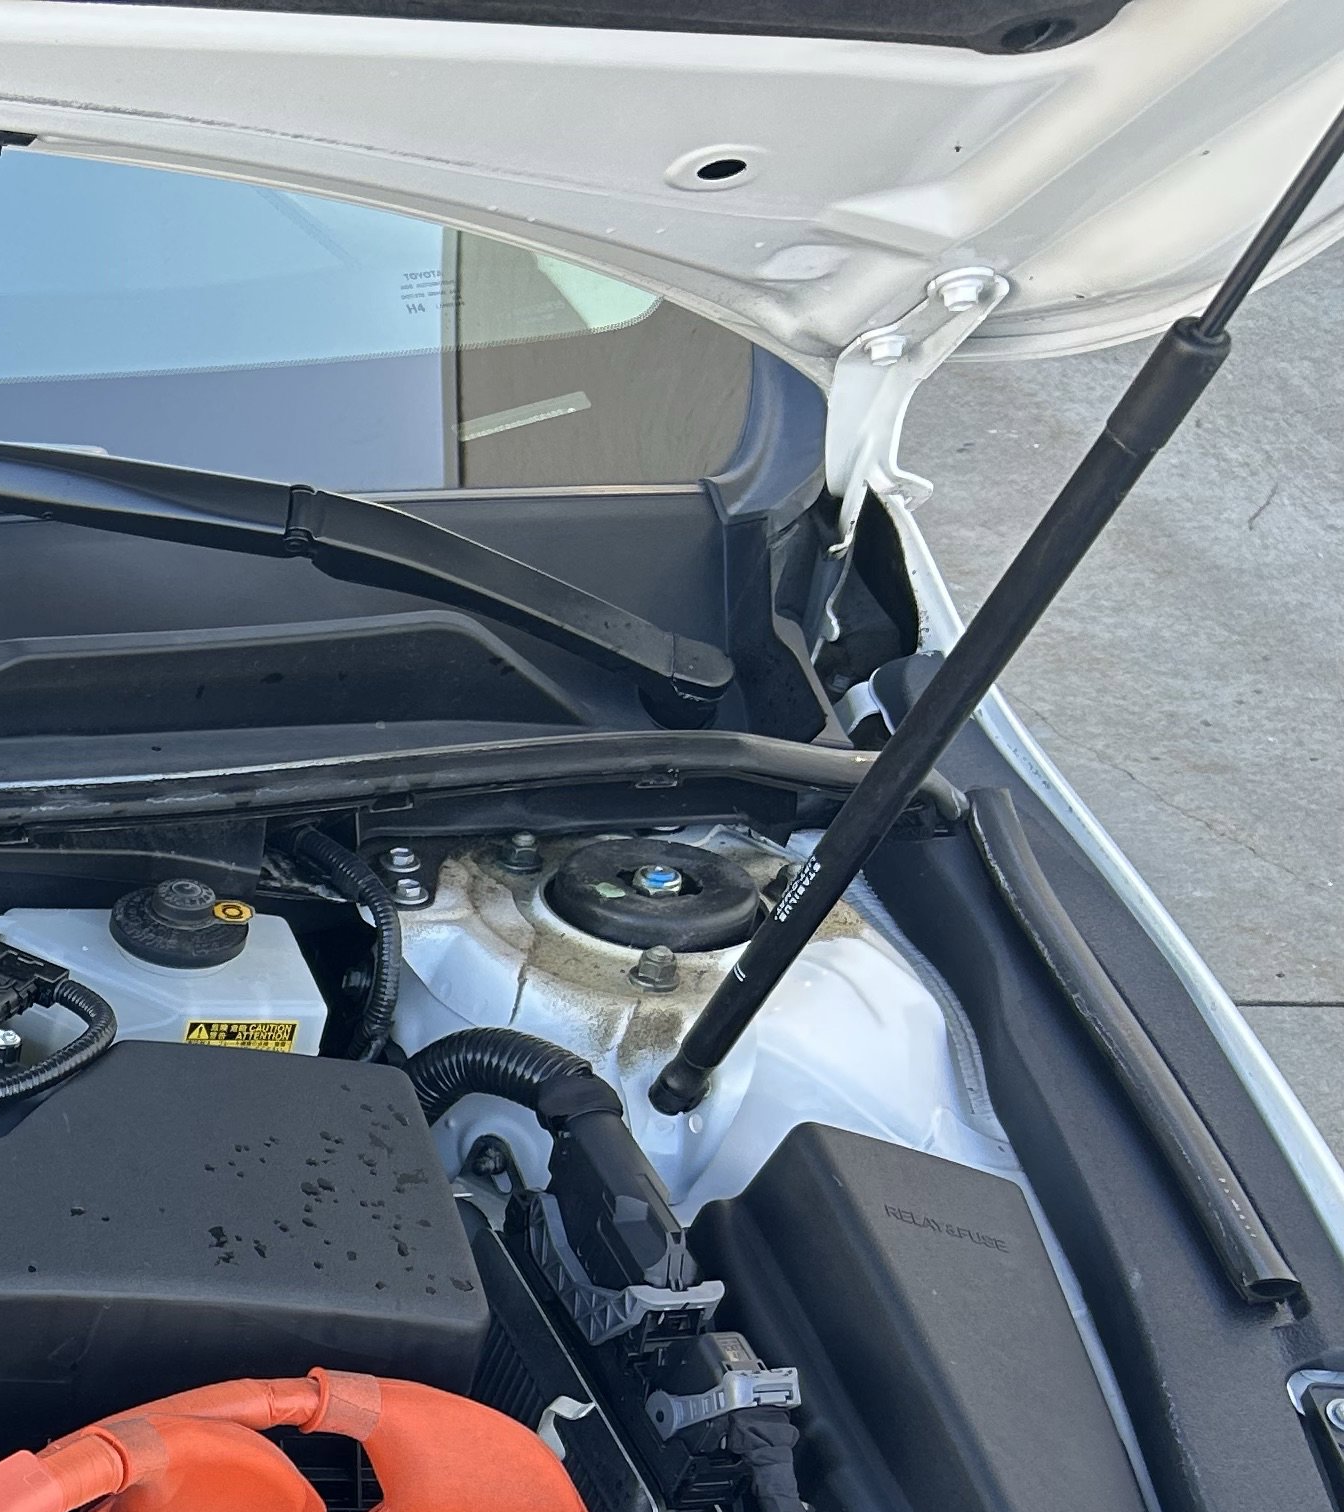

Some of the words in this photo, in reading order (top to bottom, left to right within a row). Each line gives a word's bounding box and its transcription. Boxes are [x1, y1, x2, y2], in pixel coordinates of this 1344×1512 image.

[779, 862, 821, 922] STABILUS
[235, 1032, 290, 1040] ATTENTION
[249, 1024, 293, 1032] CAUTION
[884, 1204, 943, 1232] RELAY
